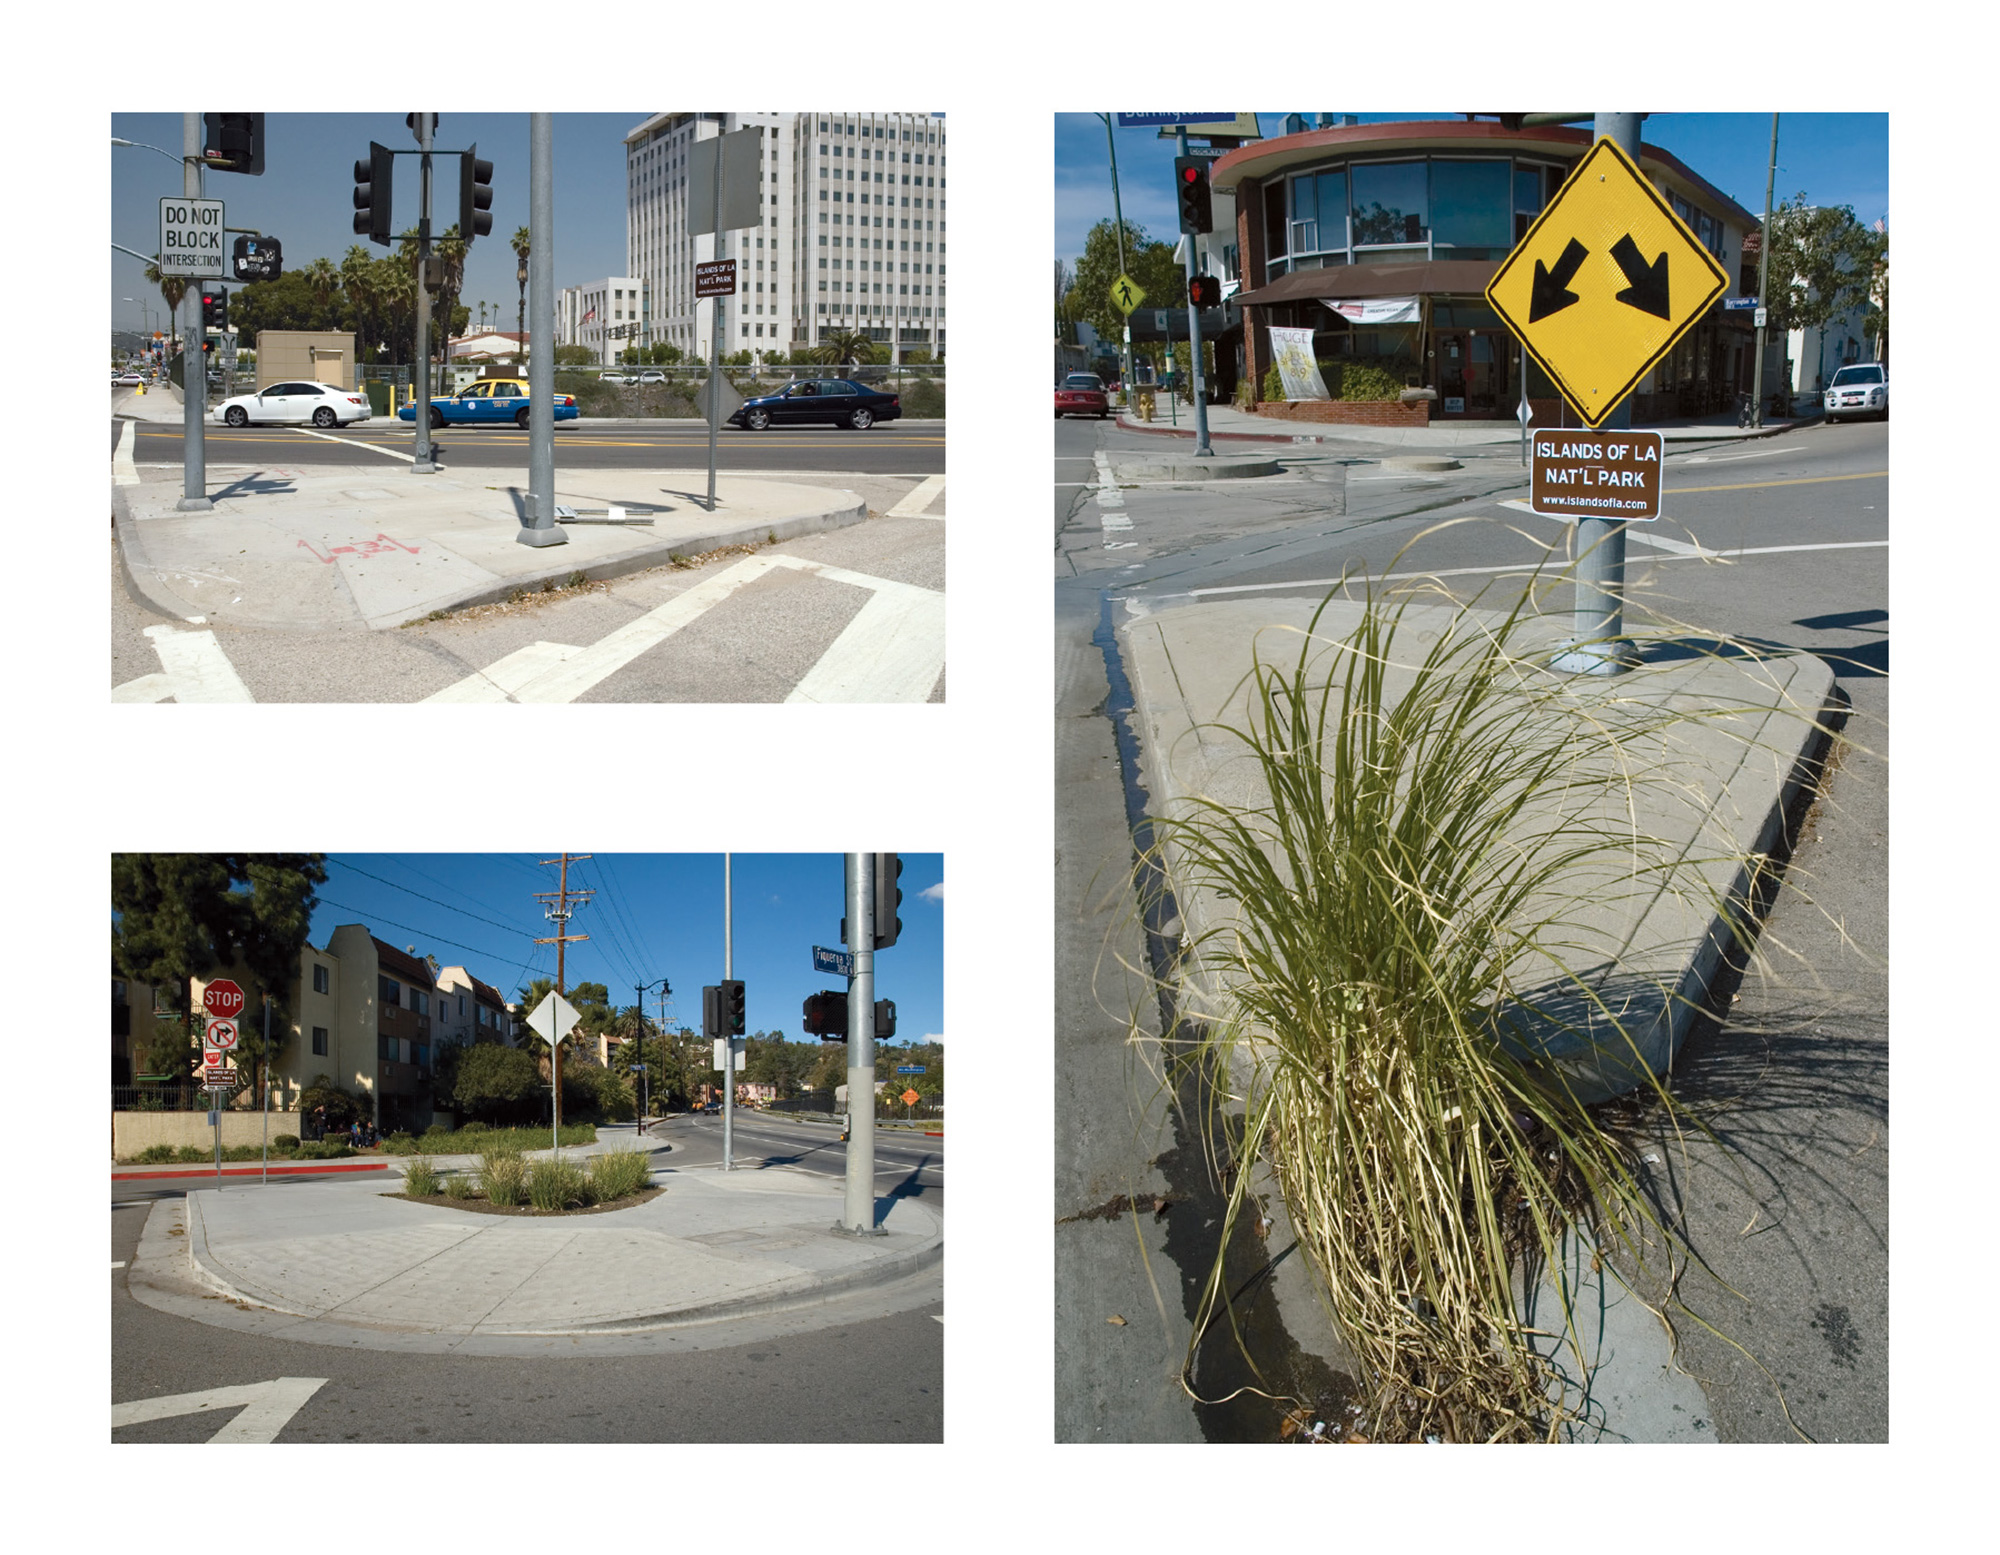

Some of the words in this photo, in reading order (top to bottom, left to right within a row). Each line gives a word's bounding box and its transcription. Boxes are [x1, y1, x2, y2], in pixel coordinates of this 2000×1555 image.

[166, 206, 187, 224] DO
[191, 207, 220, 226] NOT
[166, 230, 220, 249] BLOCK
[163, 254, 221, 268] INTERSECTION
[719, 264, 726, 273] OF
[727, 263, 736, 271] LA
[715, 275, 732, 284] PARK
[1273, 331, 1308, 344] HUGE
[1537, 441, 1603, 460] ISLANDS
[1607, 444, 1629, 461] OF
[1635, 444, 1657, 462] LA
[1546, 467, 1593, 485] NAT'L
[1598, 469, 1645, 488] PARK
[1542, 495, 1647, 510] www.islandsofla.com
[817, 947, 843, 965] Figueroa
[205, 990, 242, 1007] STOP
